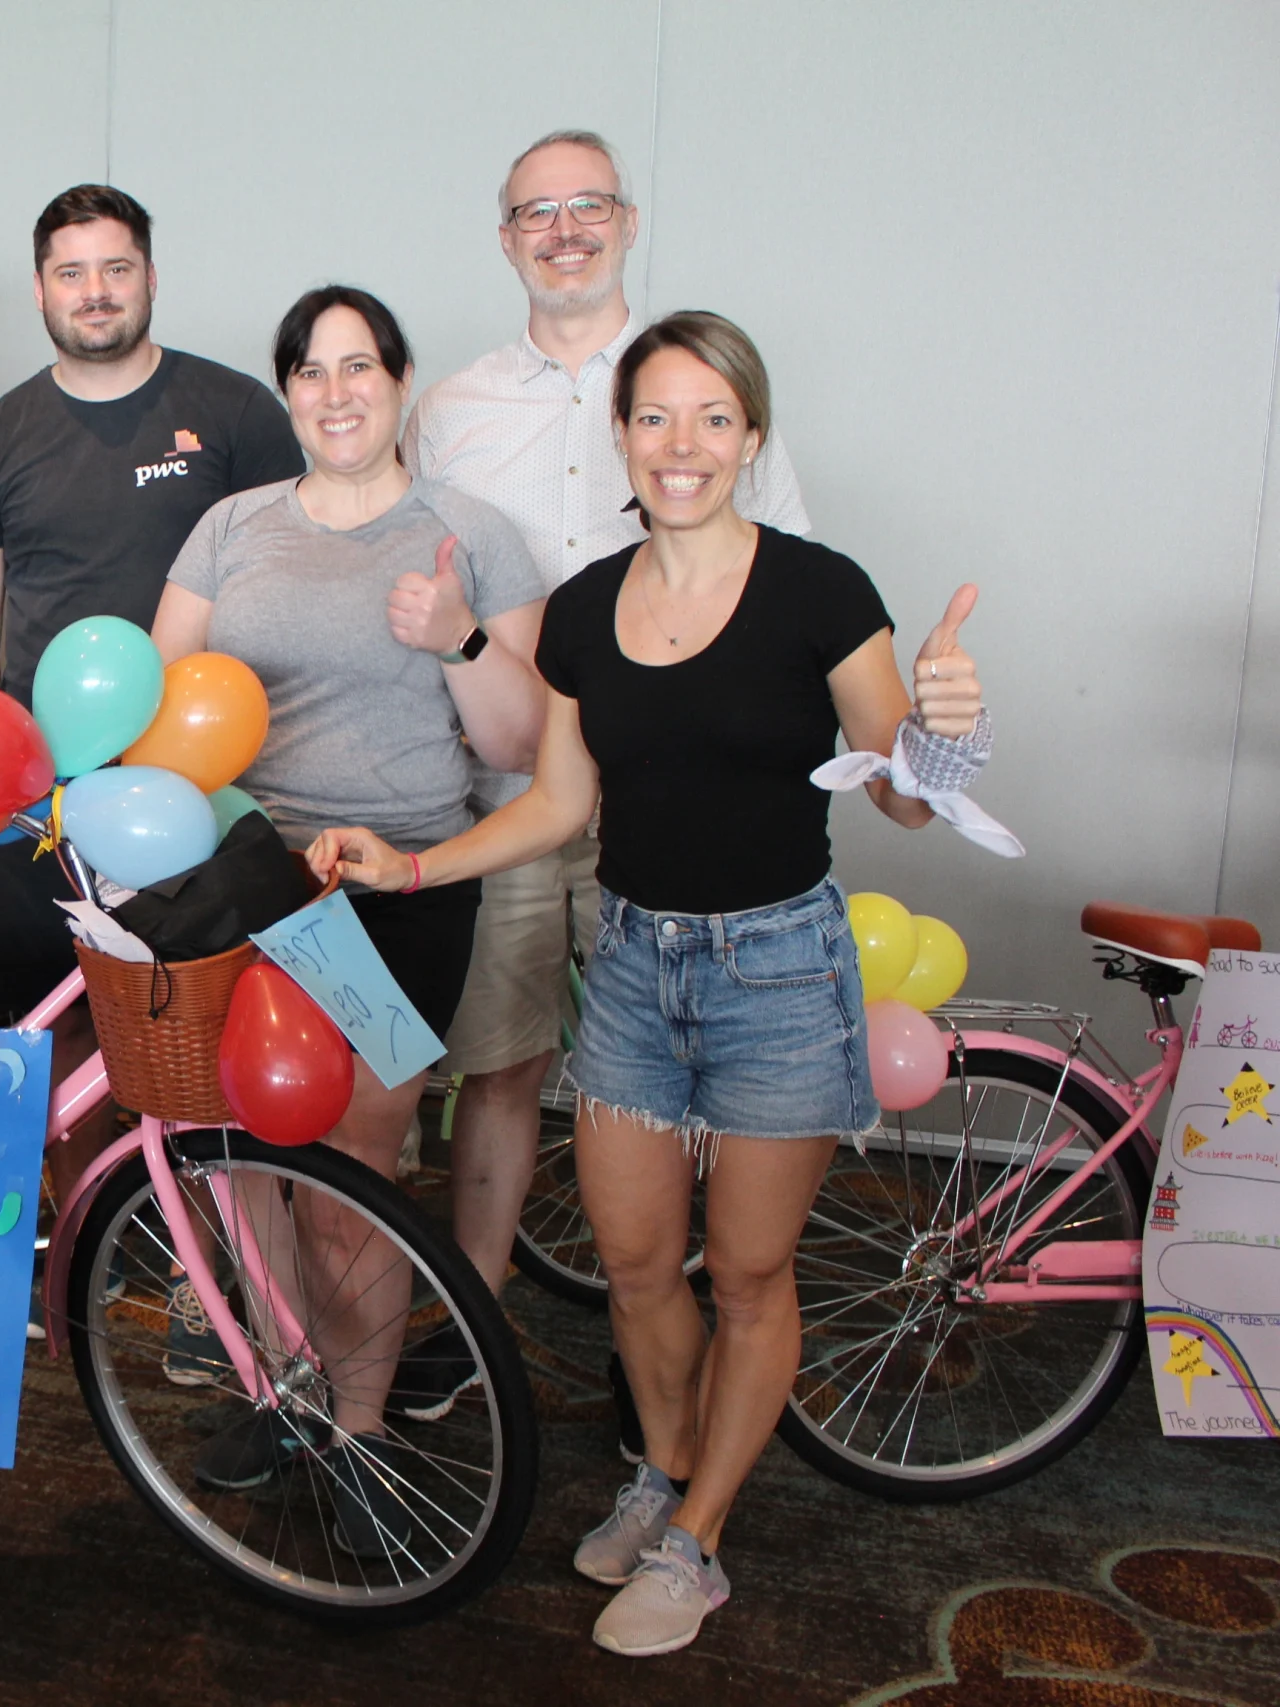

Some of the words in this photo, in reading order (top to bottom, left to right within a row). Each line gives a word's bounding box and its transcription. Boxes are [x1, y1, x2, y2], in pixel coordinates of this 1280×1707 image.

[135, 460, 189, 488] pwc
[1236, 951, 1254, 972] to
[1165, 1410, 1197, 1430] The
